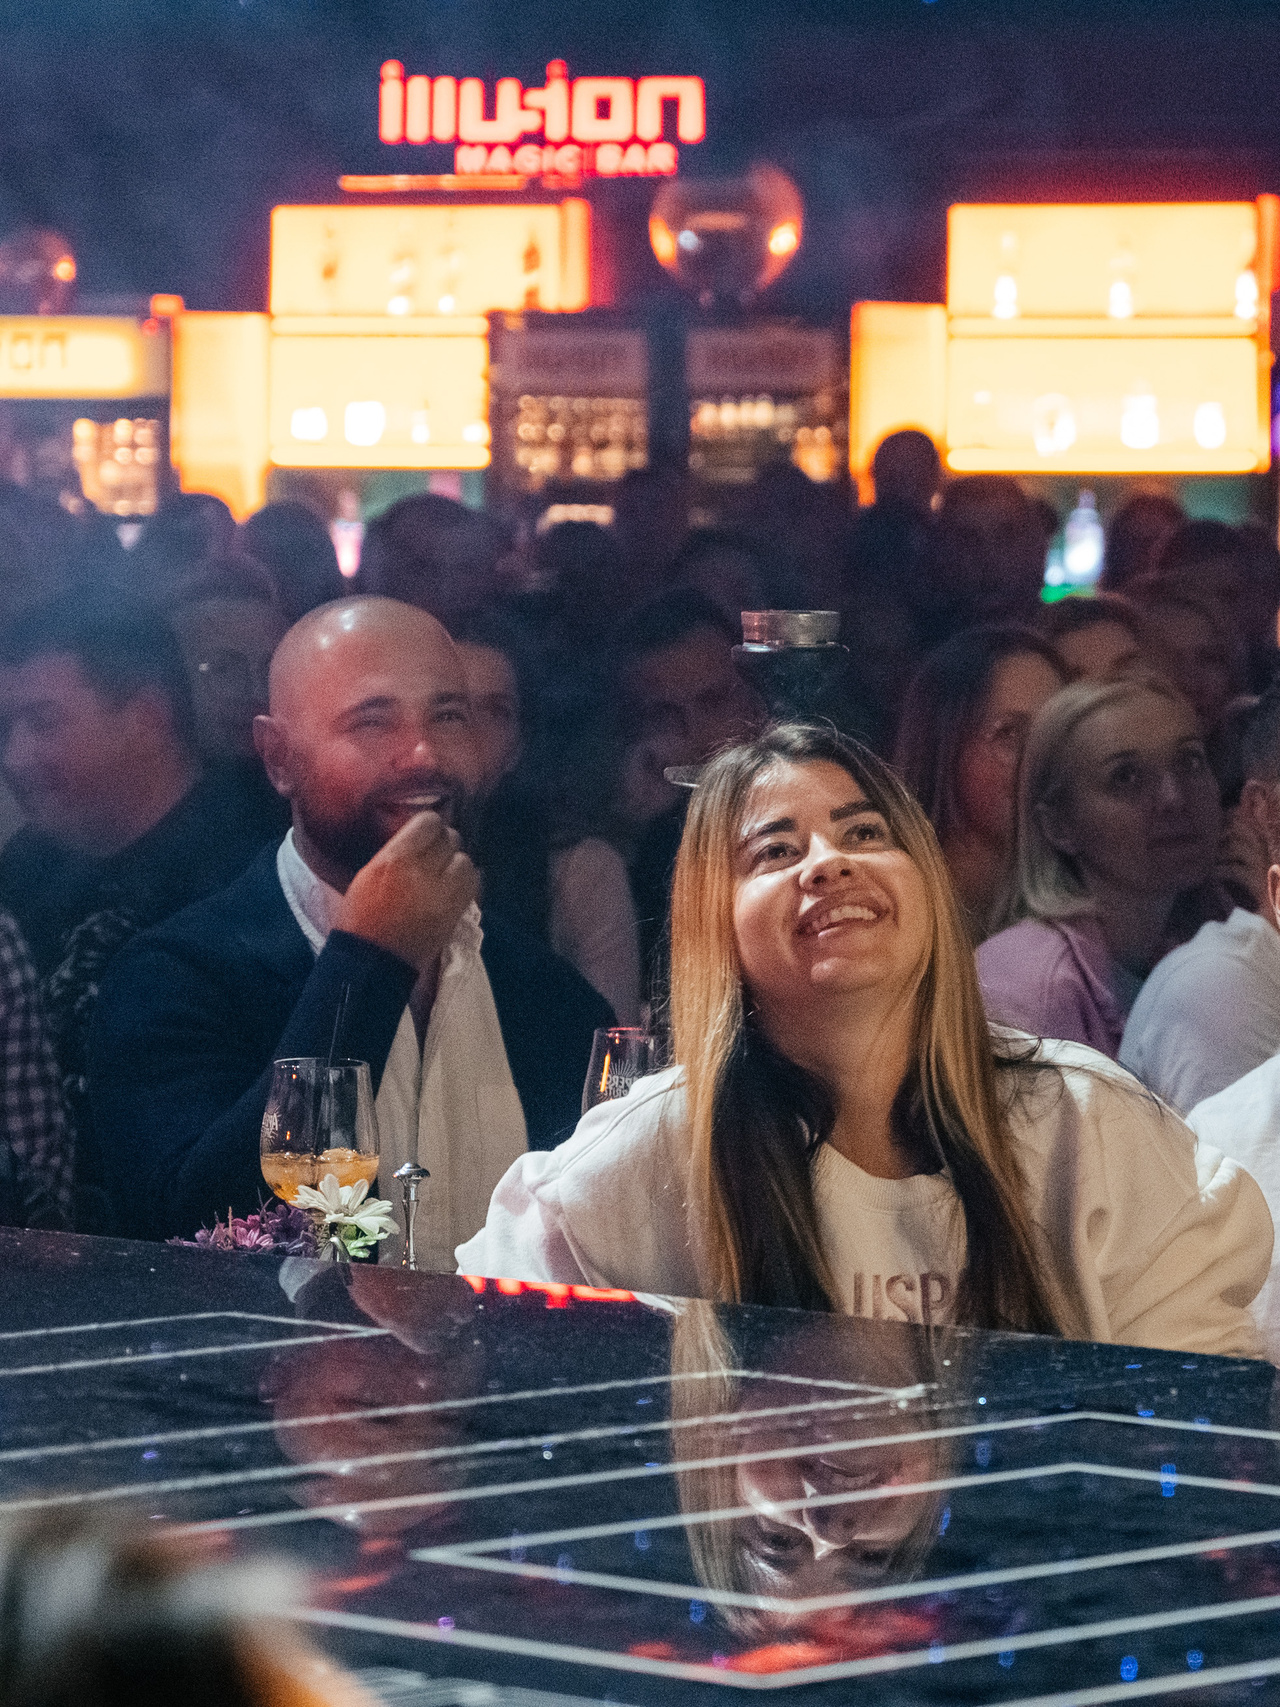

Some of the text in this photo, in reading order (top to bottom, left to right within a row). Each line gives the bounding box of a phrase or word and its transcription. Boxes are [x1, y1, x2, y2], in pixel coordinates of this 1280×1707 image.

[454, 142, 678, 177] MAGIC BAR
[1, 331, 67, 370] on
